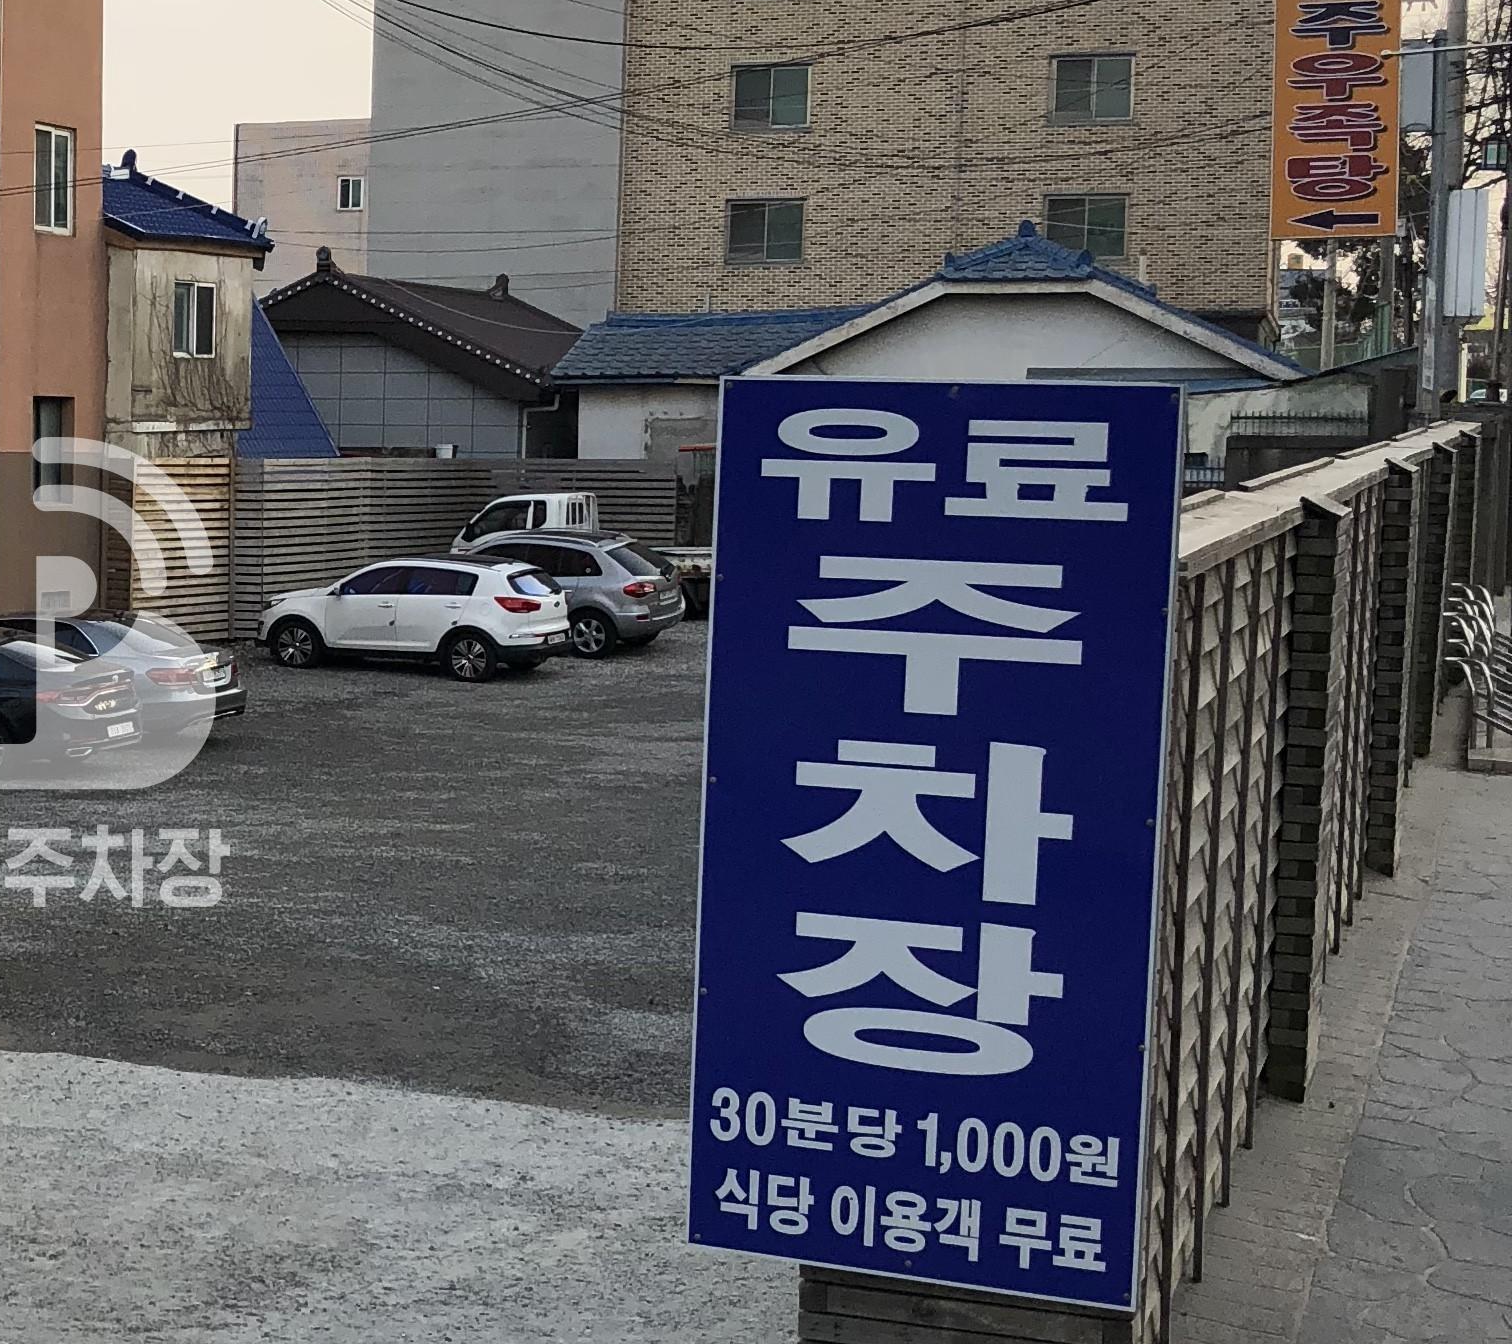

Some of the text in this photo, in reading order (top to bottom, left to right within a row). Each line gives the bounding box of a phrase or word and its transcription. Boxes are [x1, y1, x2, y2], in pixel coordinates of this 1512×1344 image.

[761, 408, 1130, 523] 유료
[776, 555, 1084, 1076] 주차장
[709, 1086, 1121, 1188] 30분당 1,000원
[714, 1167, 1107, 1273] 식당 이용객 무료
